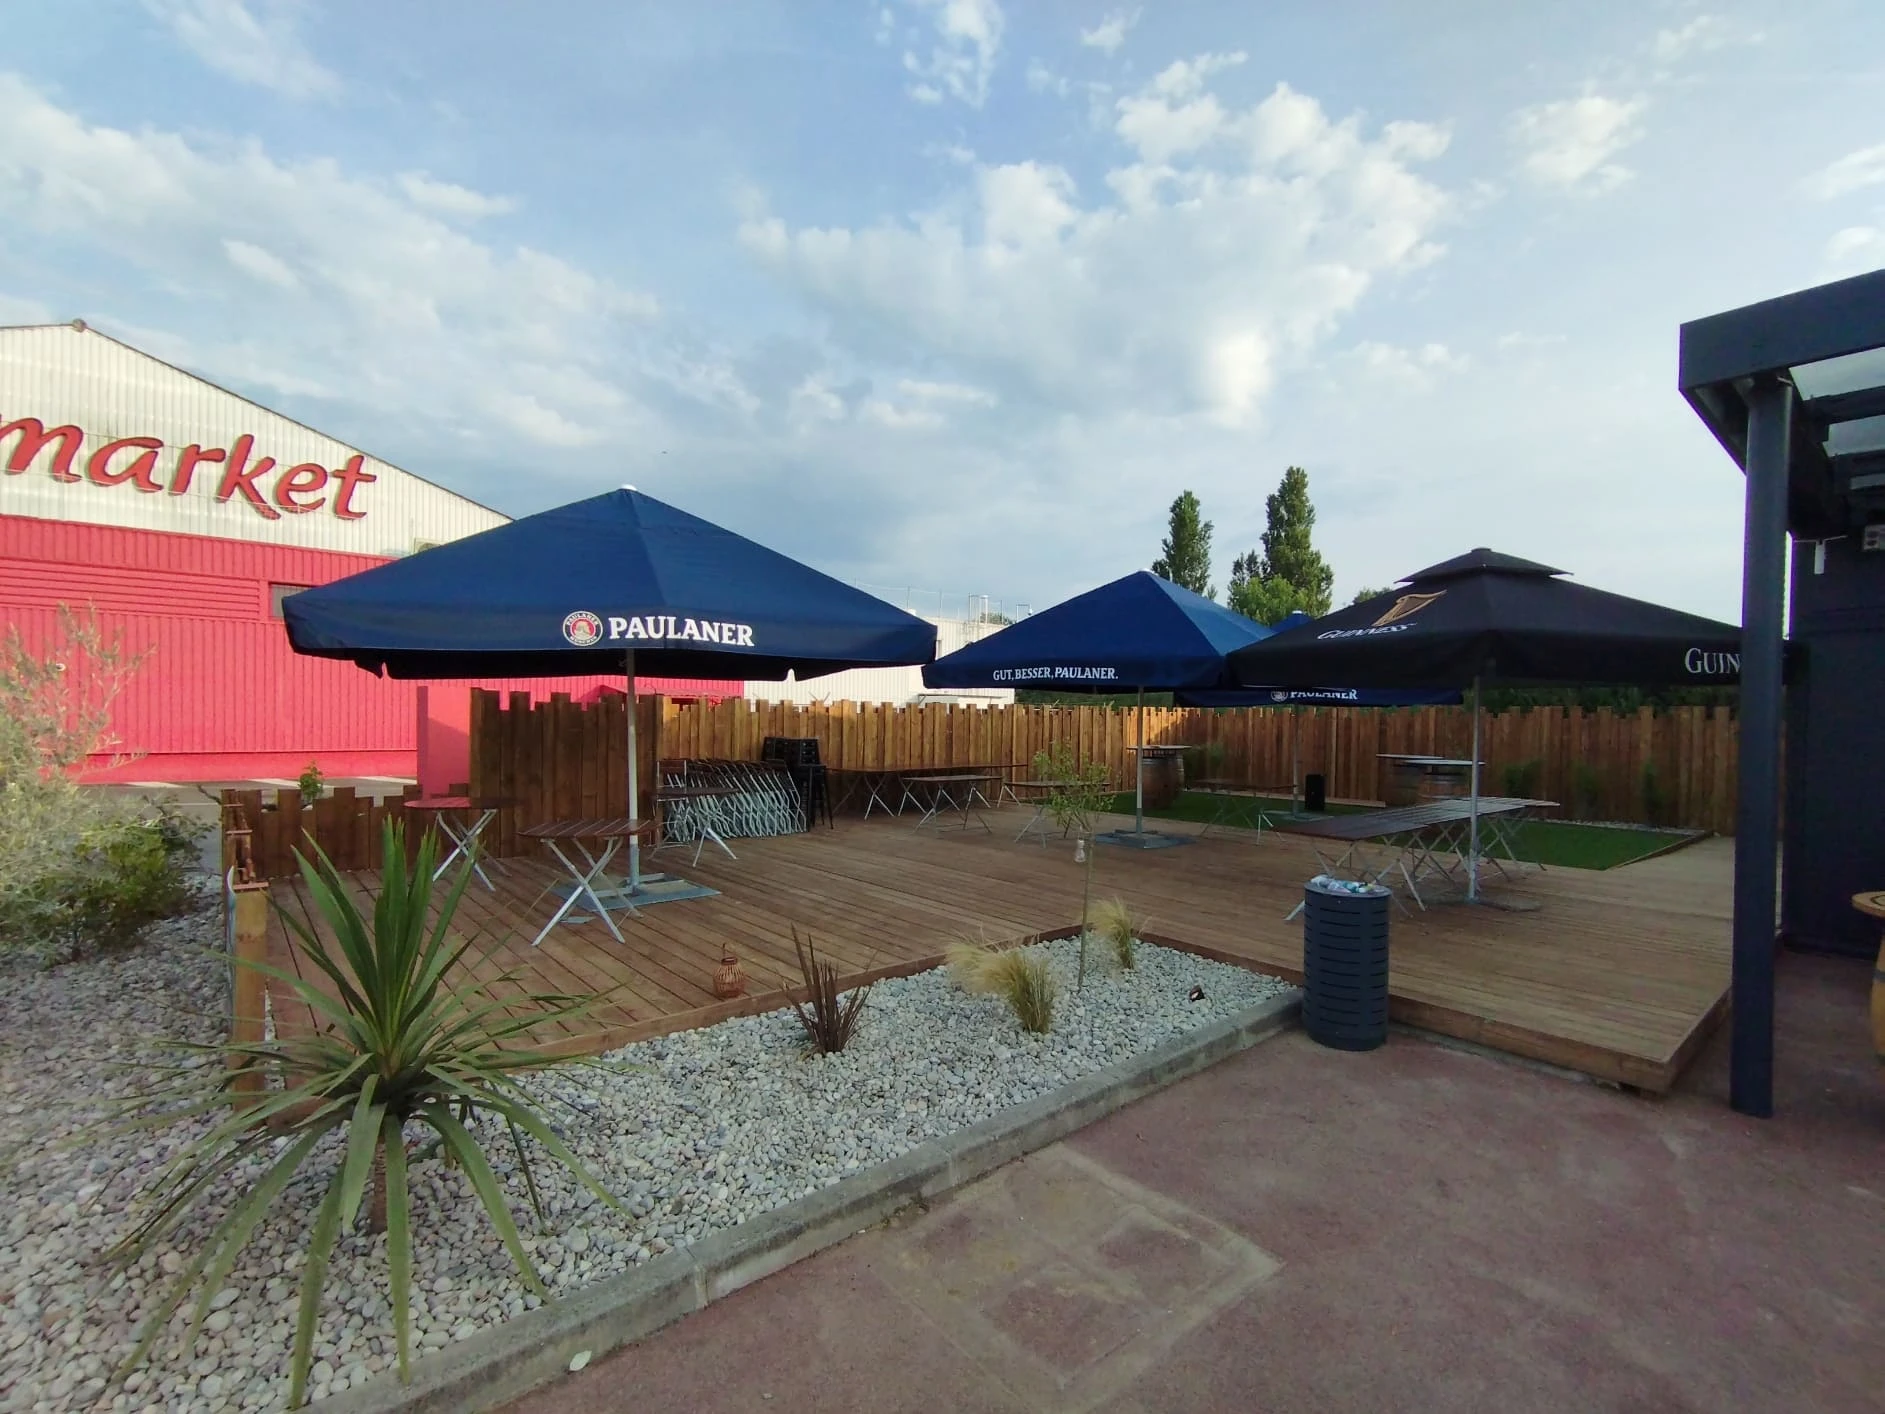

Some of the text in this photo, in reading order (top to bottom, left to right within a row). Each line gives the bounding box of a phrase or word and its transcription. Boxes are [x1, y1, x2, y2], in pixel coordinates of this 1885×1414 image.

[0, 414, 377, 521] market
[608, 616, 755, 647] PAULANER
[993, 667, 1119, 681] GUT, BESSER, PAULANER.
[1685, 647, 1740, 674] GUIN
